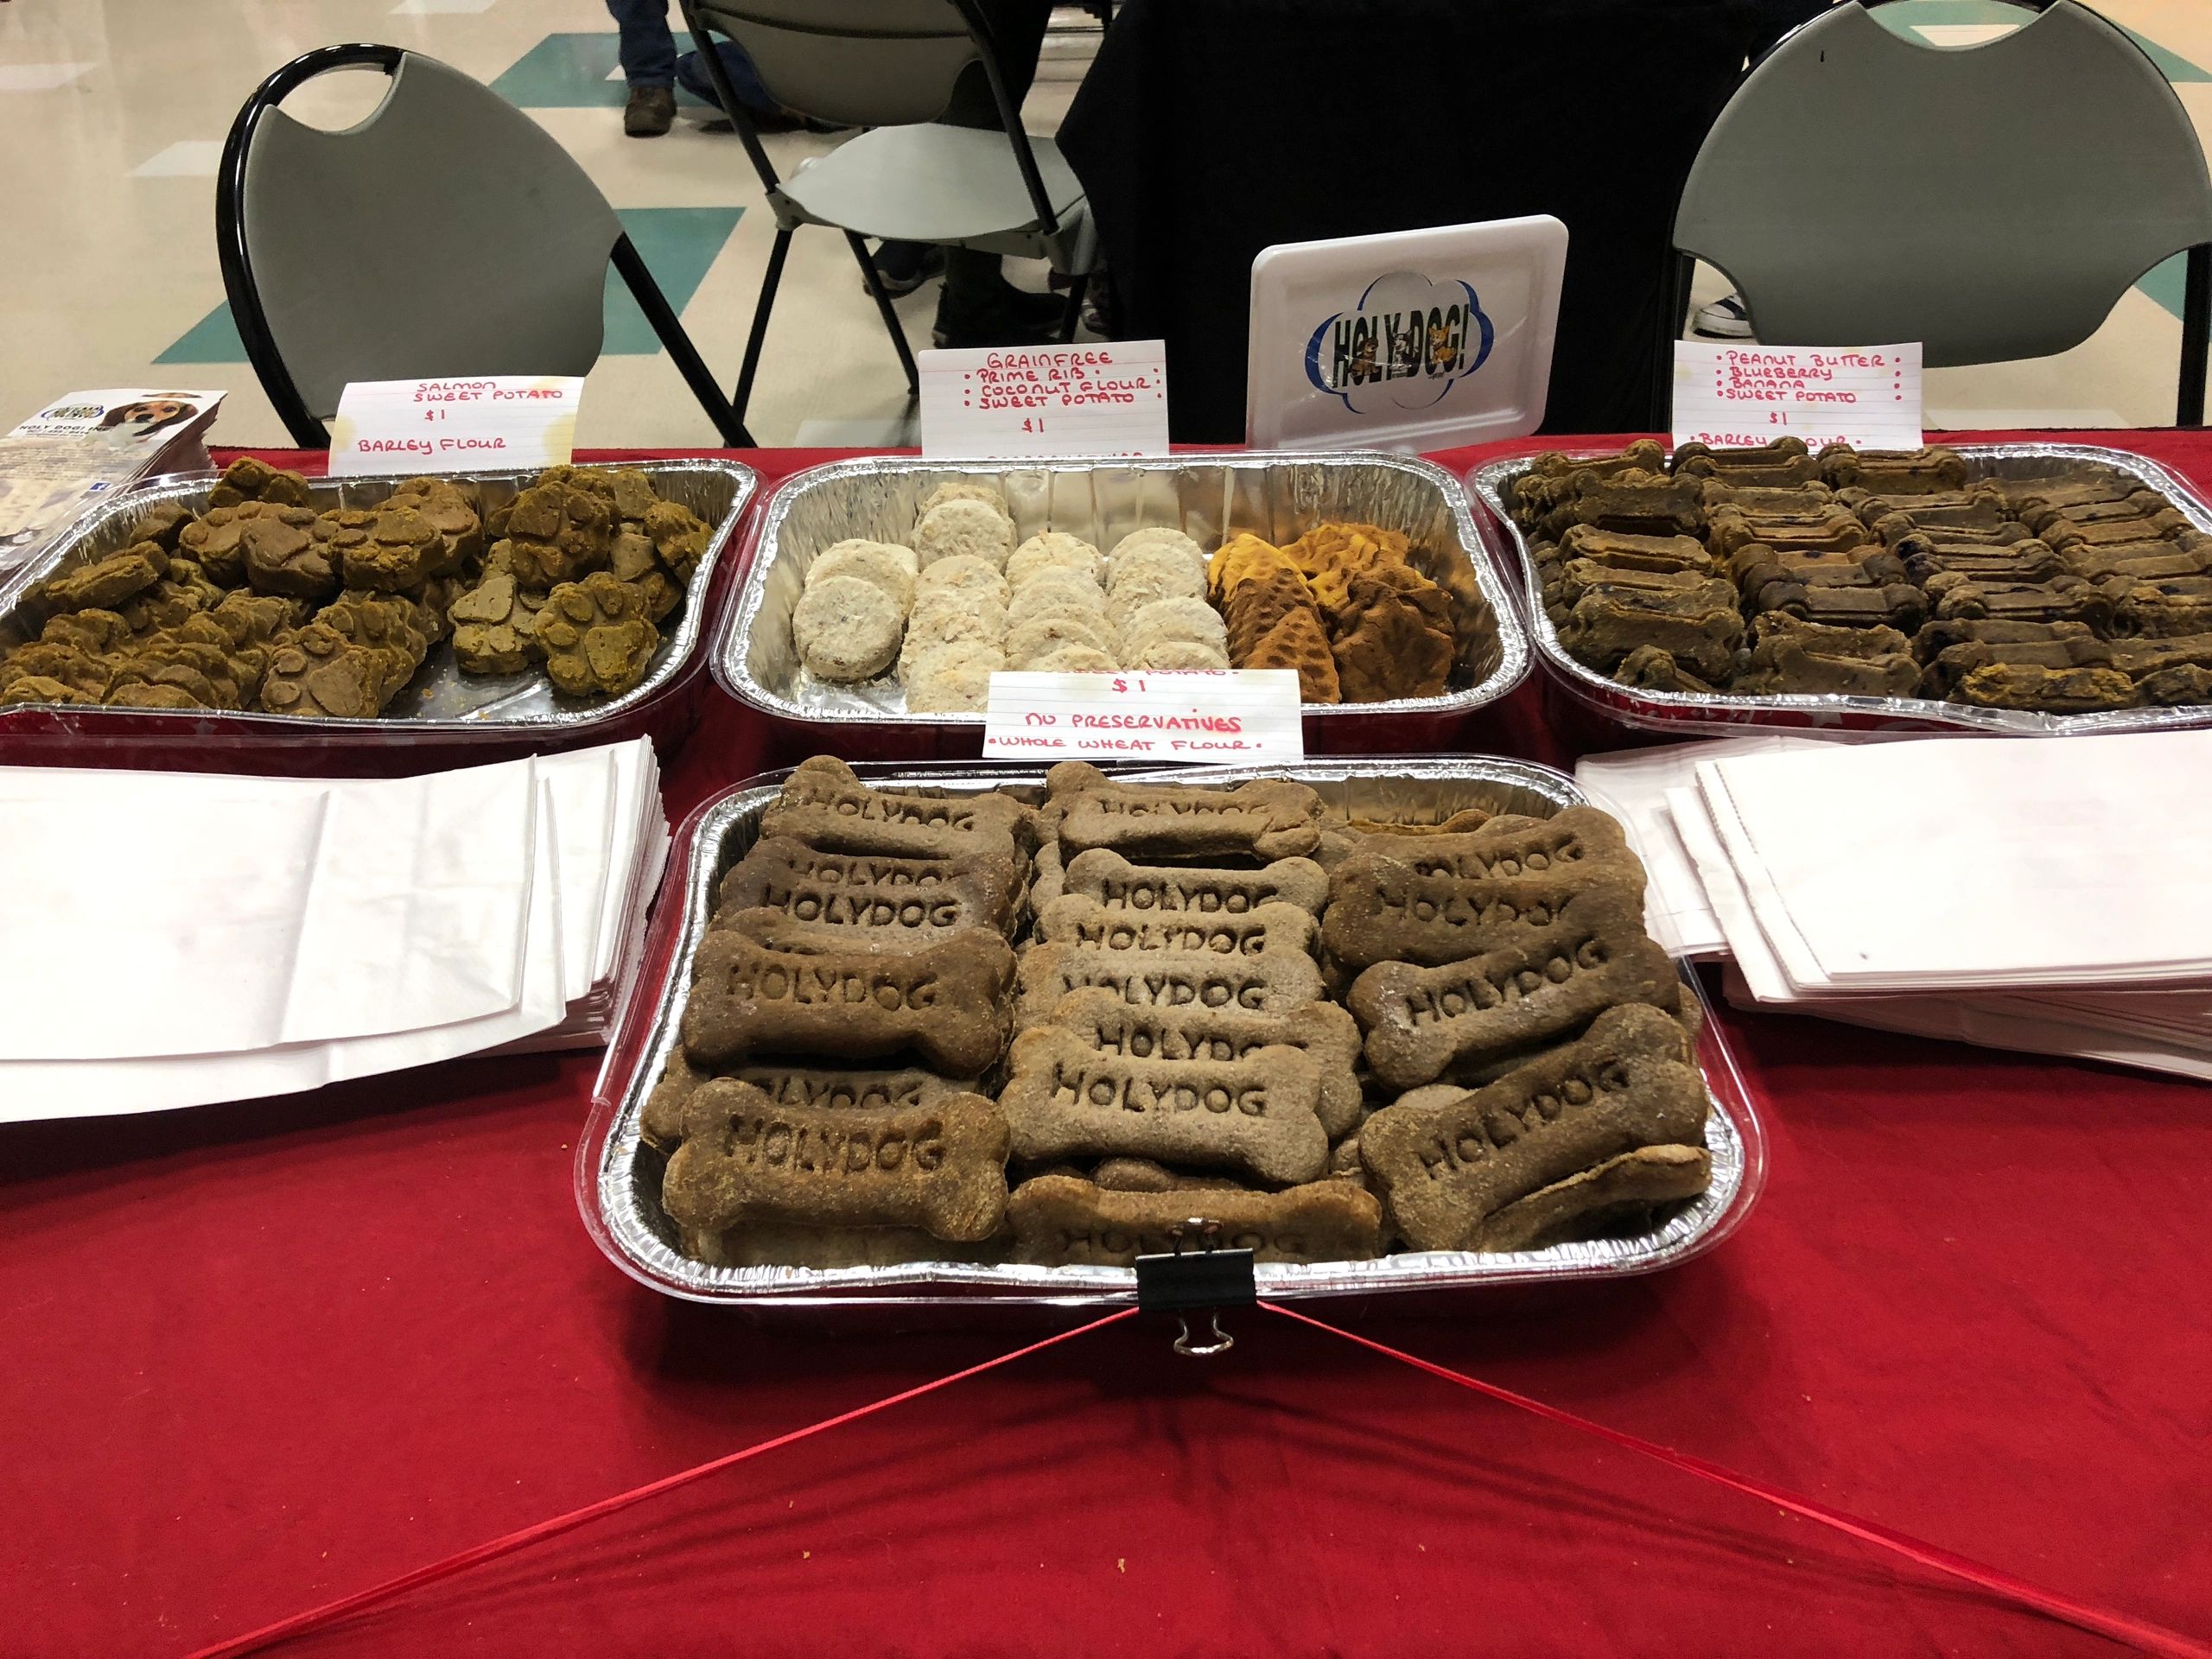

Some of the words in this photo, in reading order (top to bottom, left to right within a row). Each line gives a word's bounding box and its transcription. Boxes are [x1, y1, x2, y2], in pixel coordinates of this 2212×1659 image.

[987, 352, 1113, 368] GRAINFREE
[1726, 350, 1796, 366] PEANUT
[1810, 353, 1885, 367] BUTTER
[976, 368, 1039, 384] PRIME
[1048, 367, 1084, 381] RIB
[1729, 366, 1833, 380] BLUEBERRY
[417, 382, 497, 392] SALMON
[982, 382, 1071, 397] COCONUT
[1080, 377, 1151, 391] FLOUR
[1729, 376, 1805, 389] BANANA
[413, 391, 483, 403] SWEET
[493, 390, 563, 400] POTATO
[978, 395, 1048, 410] SWEET
[1062, 392, 1135, 407] POTATO
[1726, 390, 1788, 402] SWEET
[1796, 391, 1857, 404] POTATO
[424, 410, 446, 422] $1
[1770, 412, 1788, 425] $1
[1022, 418, 1045, 433] $1
[358, 439, 431, 454] BARLEY
[440, 437, 506, 450] FLOUR
[1698, 433, 1767, 447] BARLEY
[1026, 712, 1057, 727] NO
[1000, 737, 1067, 748] WHOLE
[1078, 740, 1156, 752] WHEAT
[1171, 741, 1252, 752] FLOUR
[1414, 833, 1585, 880] OLYDOG
[760, 881, 962, 928] HOLYDOG
[727, 963, 938, 1012] HOLYDOG
[1406, 935, 1610, 1027] HOLYDOG
[1096, 1025, 1309, 1062] HOLYD
[1050, 1060, 1268, 1116] HOLYDOG
[1417, 1056, 1630, 1181] HOLYDOG
[726, 1114, 947, 1173] HOLYDOG
